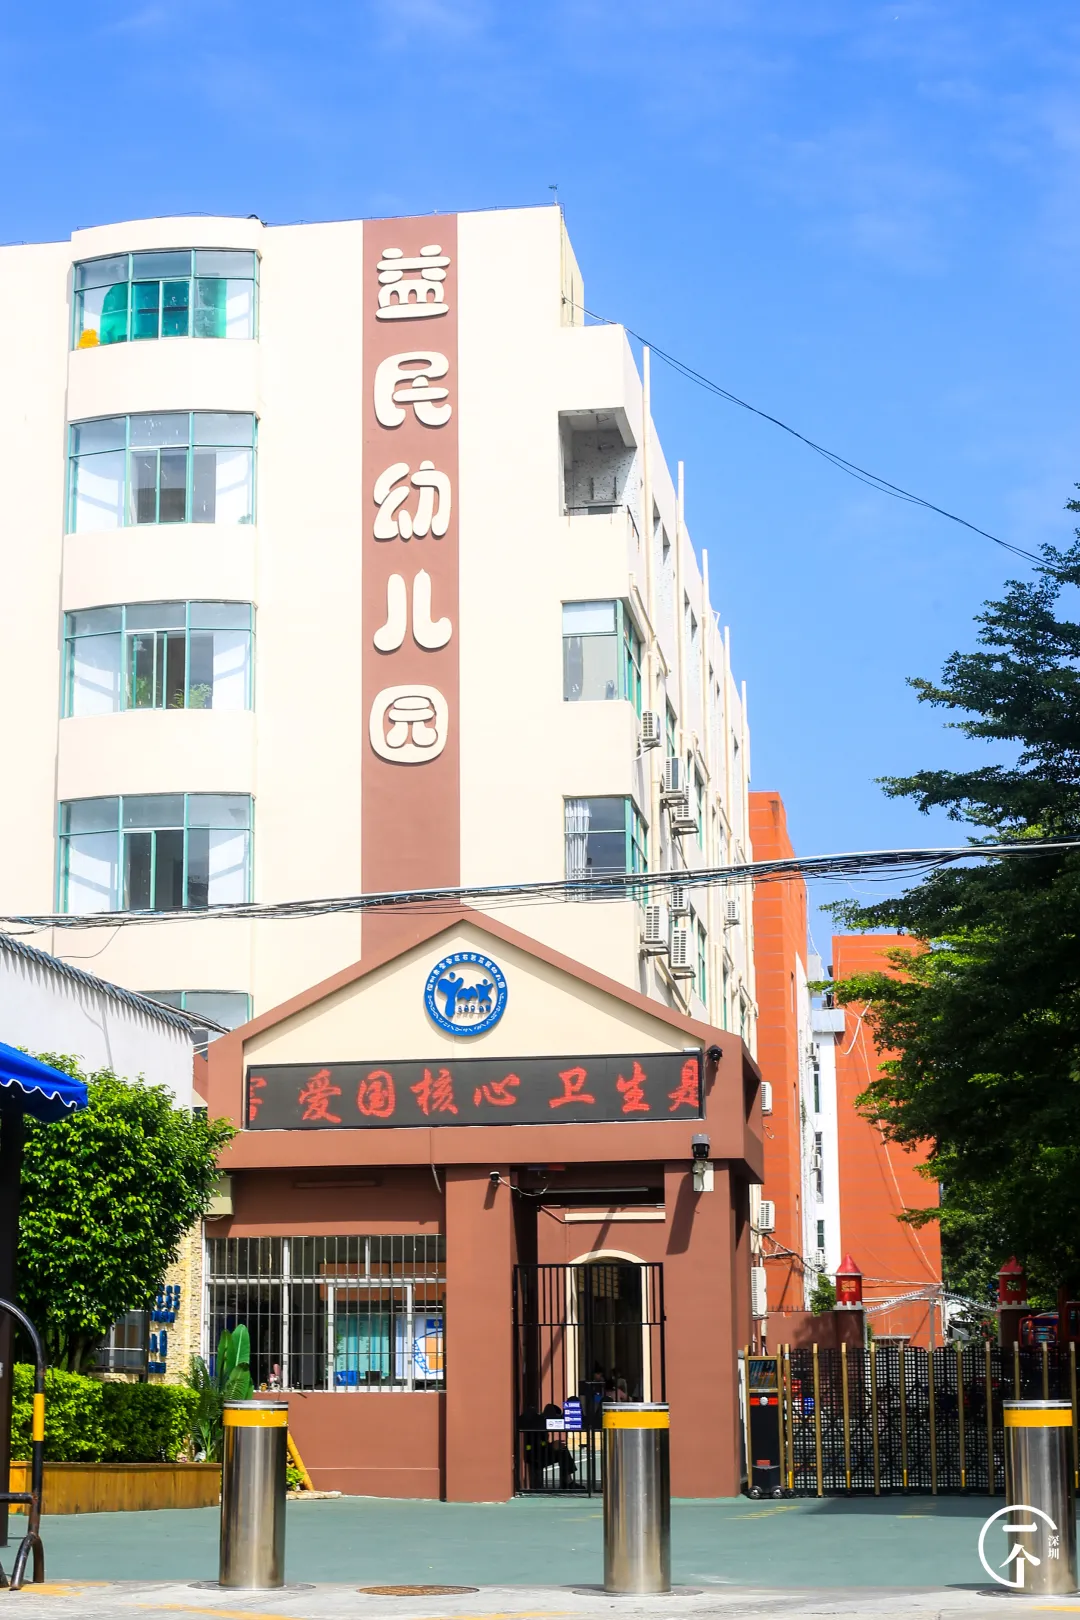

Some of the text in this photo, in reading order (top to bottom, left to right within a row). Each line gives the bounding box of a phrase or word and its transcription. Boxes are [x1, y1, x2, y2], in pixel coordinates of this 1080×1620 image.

[369, 244, 453, 765] 益民幼儿园
